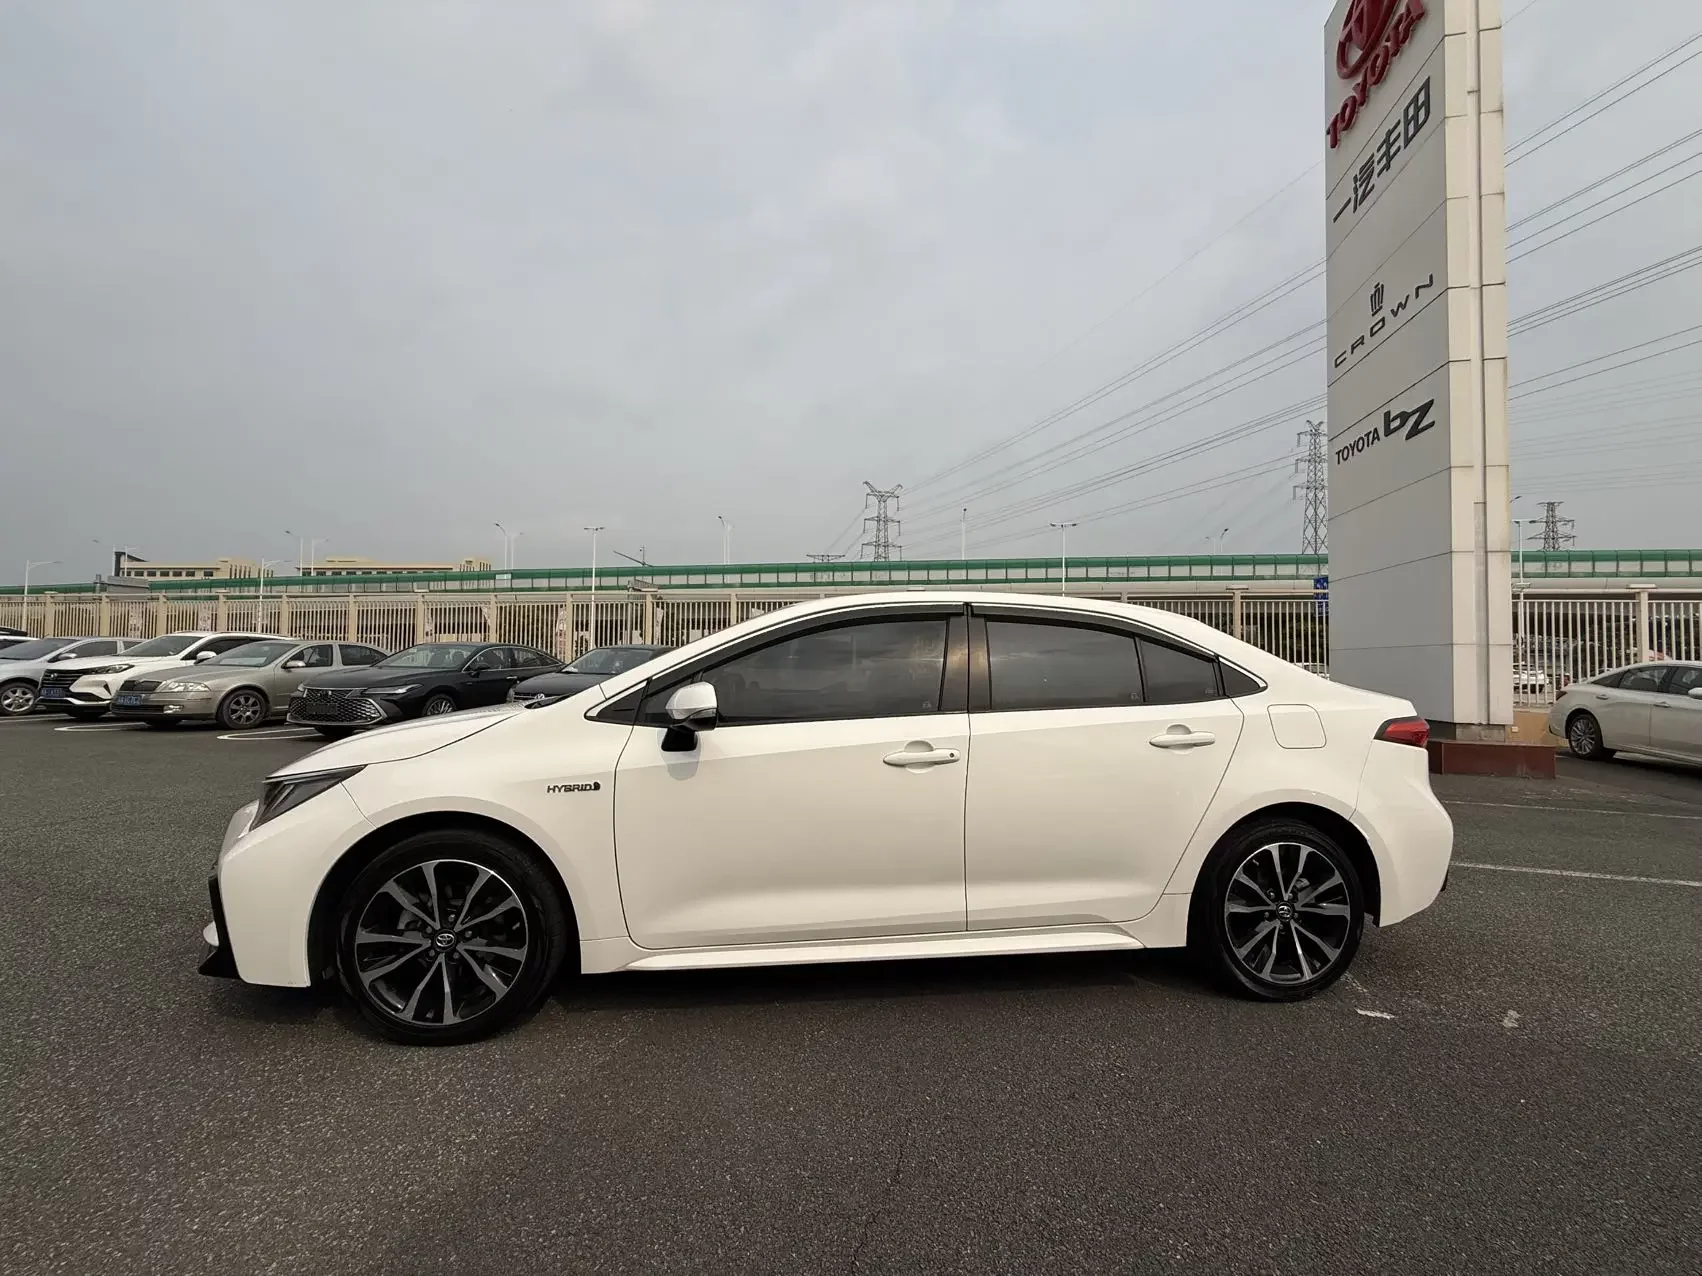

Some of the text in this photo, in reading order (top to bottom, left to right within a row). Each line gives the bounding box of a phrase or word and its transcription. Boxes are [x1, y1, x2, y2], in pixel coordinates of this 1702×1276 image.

[1326, 0, 1425, 149] TOYOTA
[1332, 75, 1431, 223] 一汽丰田
[1334, 273, 1434, 368] CROWN
[1335, 427, 1380, 465] TOYOTA
[546, 784, 592, 793] HYBRID
